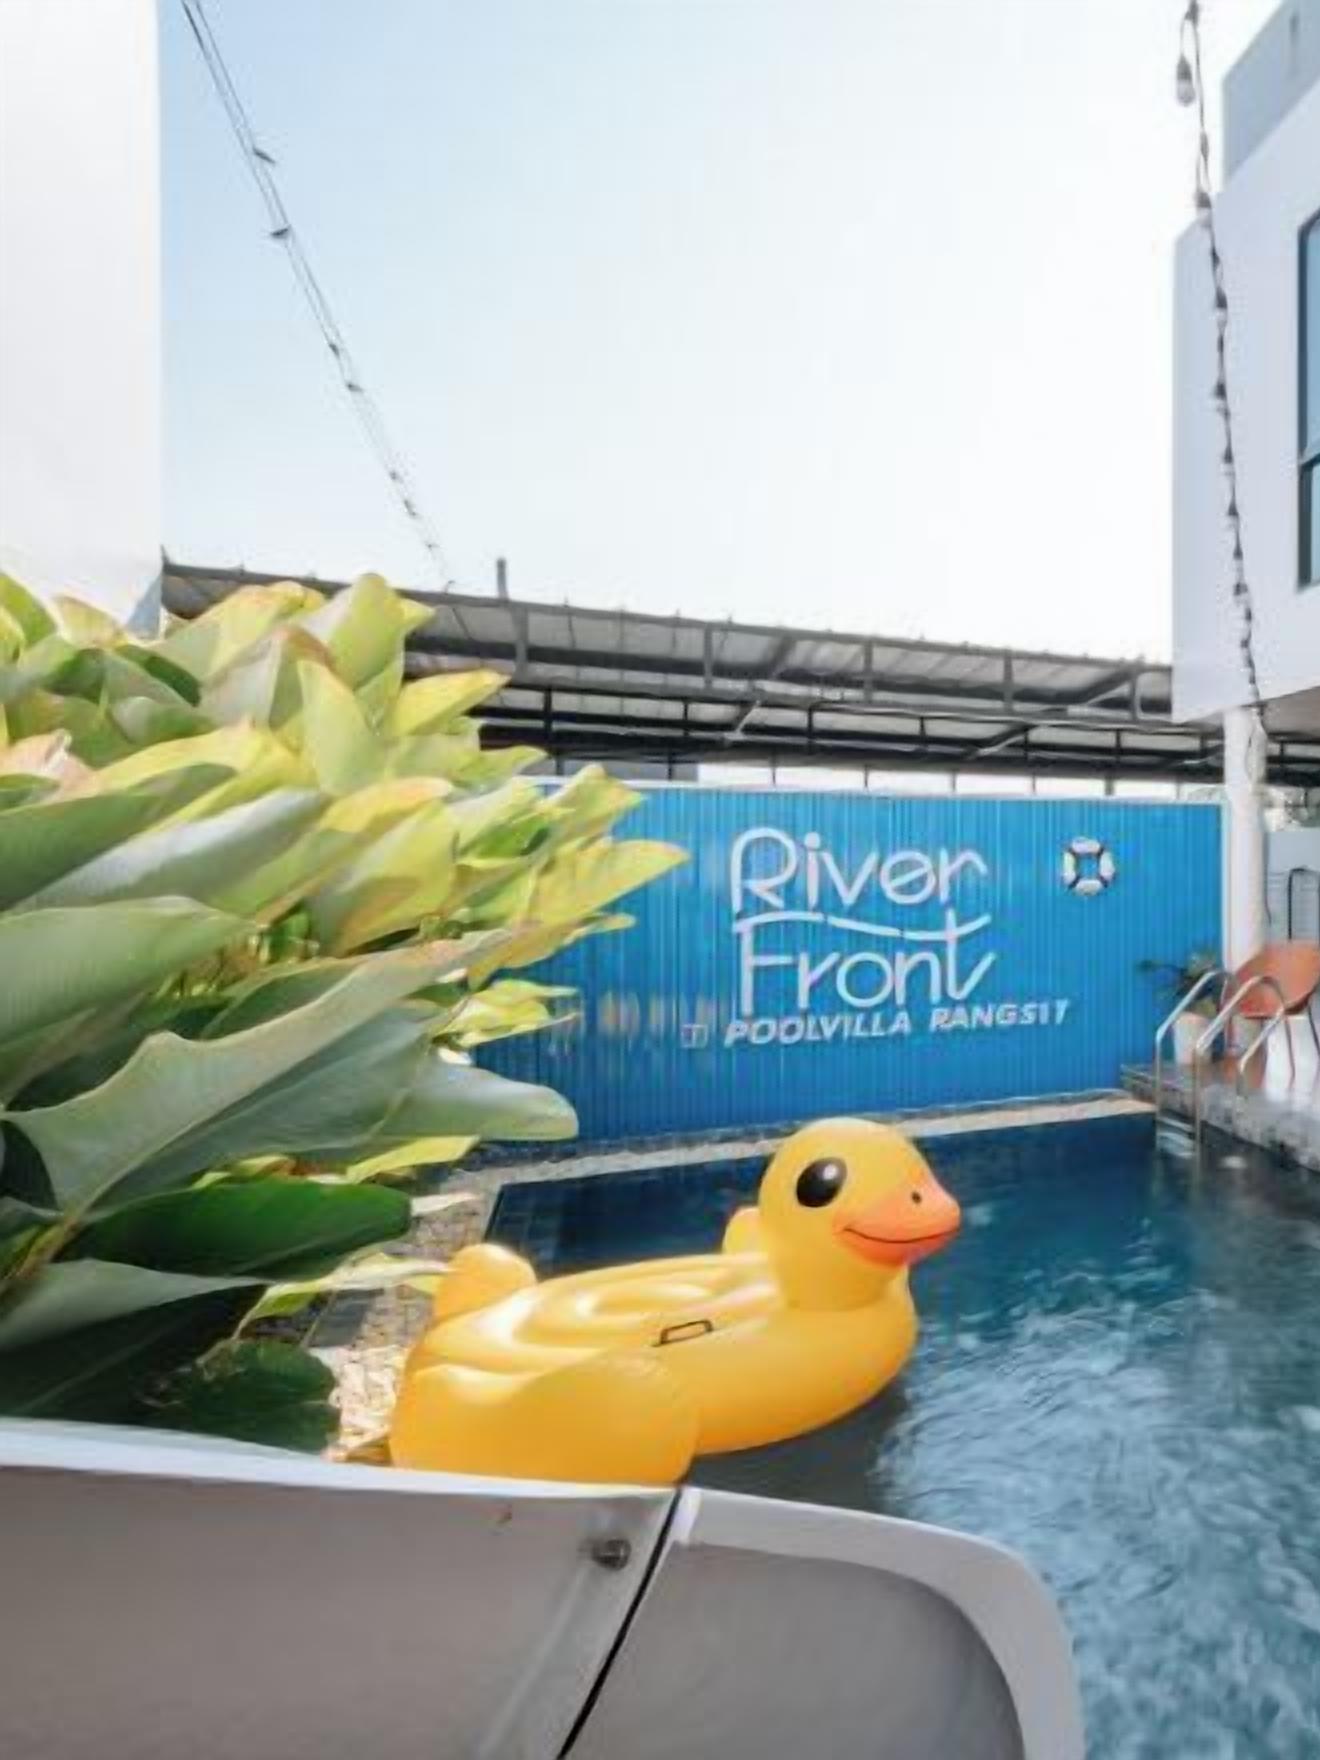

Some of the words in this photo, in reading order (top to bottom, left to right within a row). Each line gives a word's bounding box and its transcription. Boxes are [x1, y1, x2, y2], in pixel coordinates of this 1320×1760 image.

[730, 826, 989, 911] River
[731, 907, 997, 1016] Front
[723, 1009, 913, 1049] POOLVILLA
